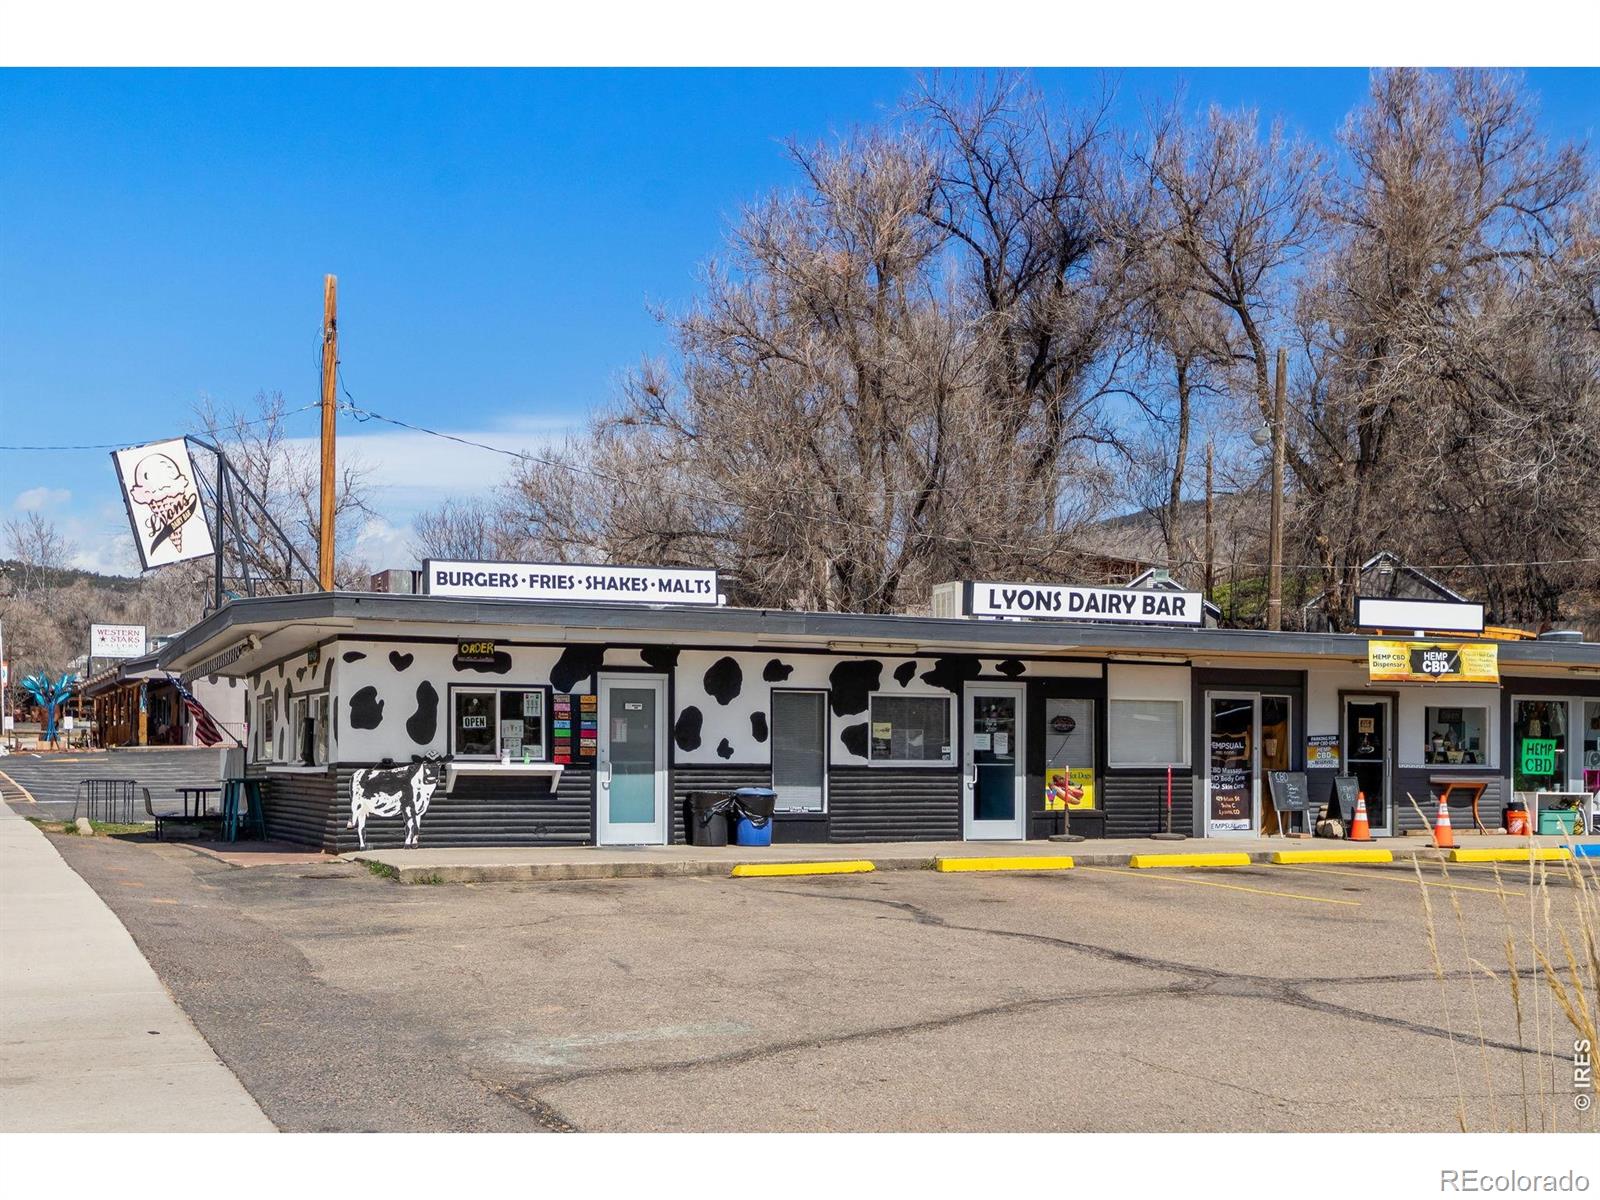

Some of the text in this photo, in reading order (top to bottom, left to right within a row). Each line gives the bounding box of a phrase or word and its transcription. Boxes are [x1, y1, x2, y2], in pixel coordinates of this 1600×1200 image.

[145, 495, 190, 538] Lyons
[436, 571, 711, 594] BURGERS FRIES SHAKES MALTS
[989, 588, 1186, 616] LYONS DAIRY BAR
[461, 642, 495, 655] ORDER
[1423, 651, 1448, 661] HEMP
[1372, 661, 1406, 669] Dispensary
[1422, 660, 1449, 673] CBD
[464, 717, 485, 727] OPEN
[1526, 742, 1553, 756] HEMP
[1525, 758, 1552, 773] CBD
